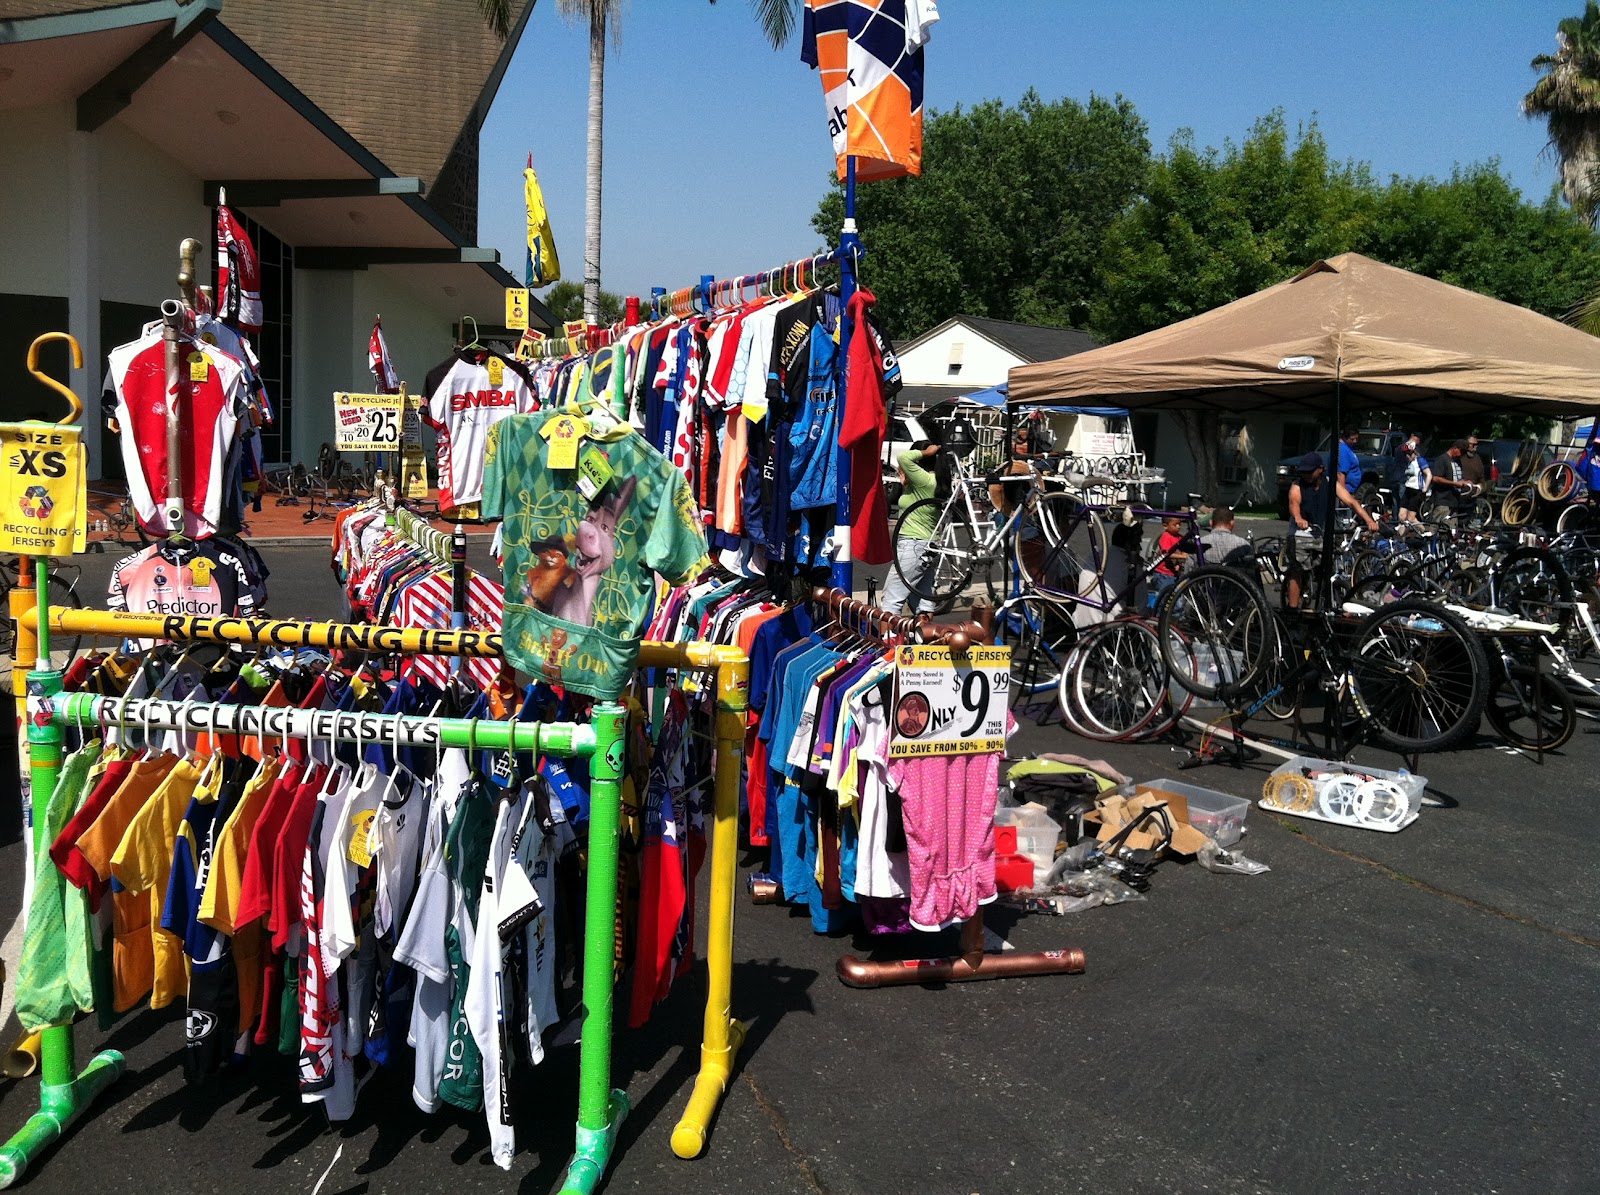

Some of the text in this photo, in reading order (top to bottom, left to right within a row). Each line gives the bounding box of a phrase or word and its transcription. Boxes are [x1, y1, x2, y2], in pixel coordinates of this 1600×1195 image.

[514, 296, 521, 304] L
[450, 389, 516, 412] SMBA
[16, 433, 63, 446] SIZE
[3, 524, 68, 537] RECYCLING
[12, 536, 56, 548] JERSEYS
[147, 596, 218, 614] Predictor
[163, 615, 402, 653] RECYCLING
[918, 651, 1012, 663] RECYCLING JERSEYS
[100, 696, 294, 733] RECYCLING
[891, 745, 908, 754] YOU
[910, 744, 932, 753] SAVE
[934, 743, 957, 752] FROM
[959, 742, 978, 750] 50%
[986, 741, 1004, 749] 90%
